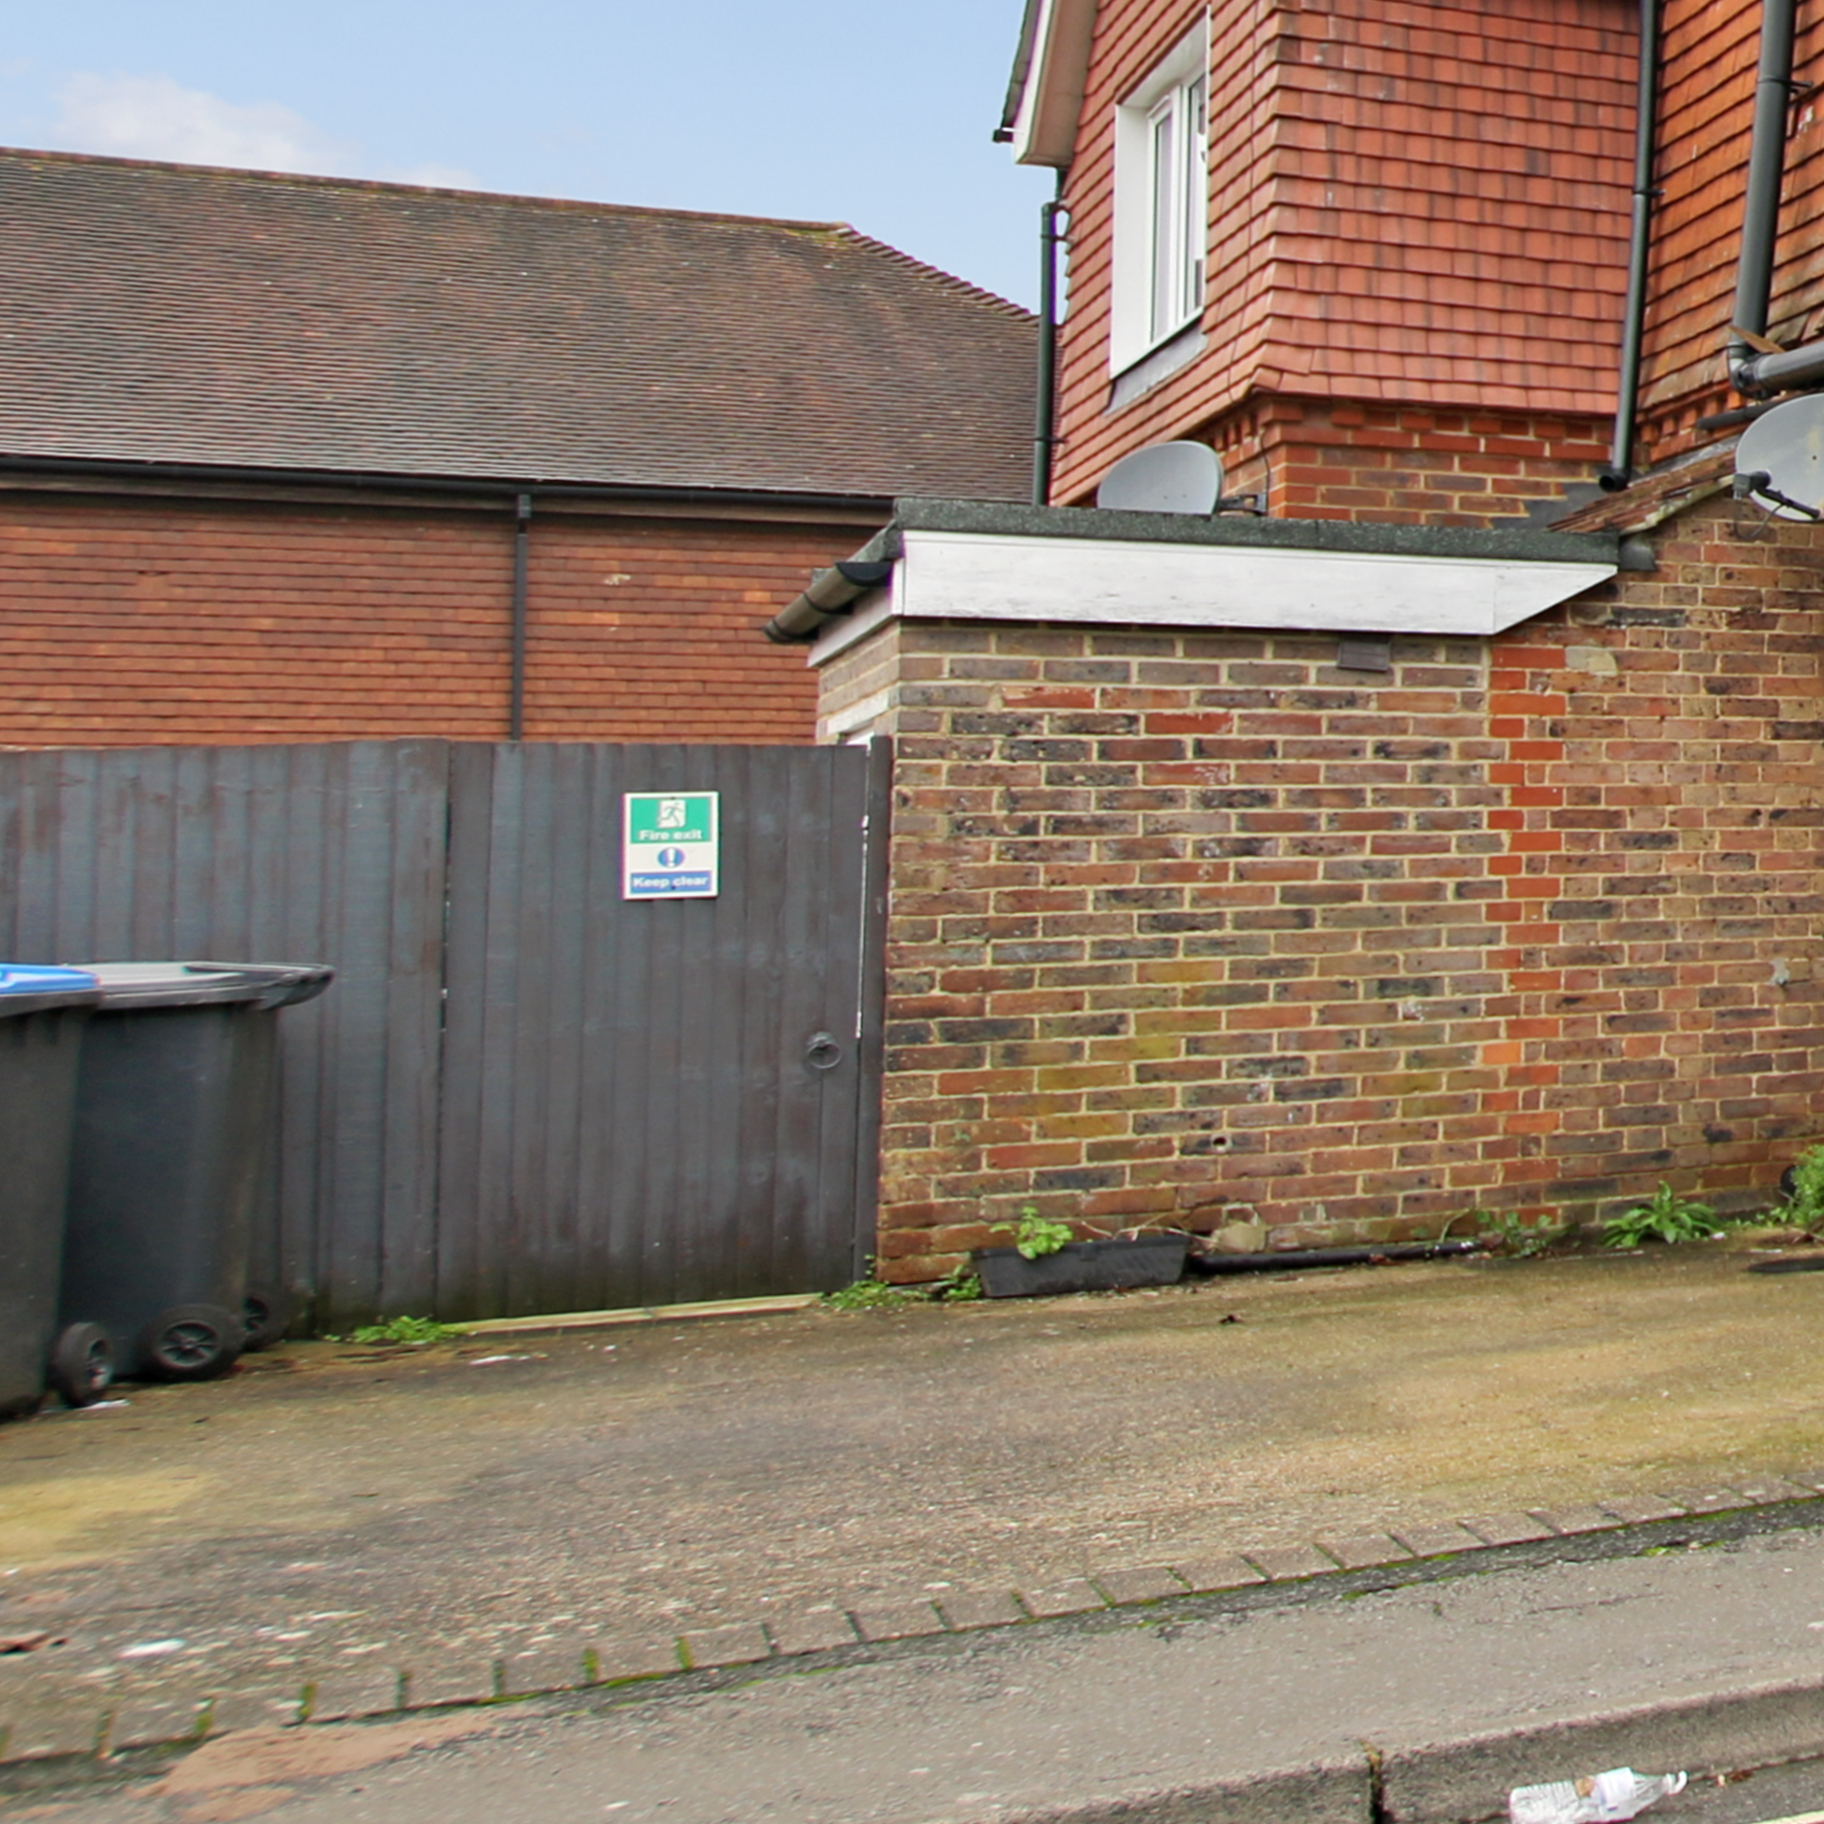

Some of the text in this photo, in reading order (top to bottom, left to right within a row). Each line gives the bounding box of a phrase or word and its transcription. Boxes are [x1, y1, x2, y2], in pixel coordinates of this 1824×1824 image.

[639, 828, 702, 841] Fire exit
[633, 876, 709, 889] Keep clear
